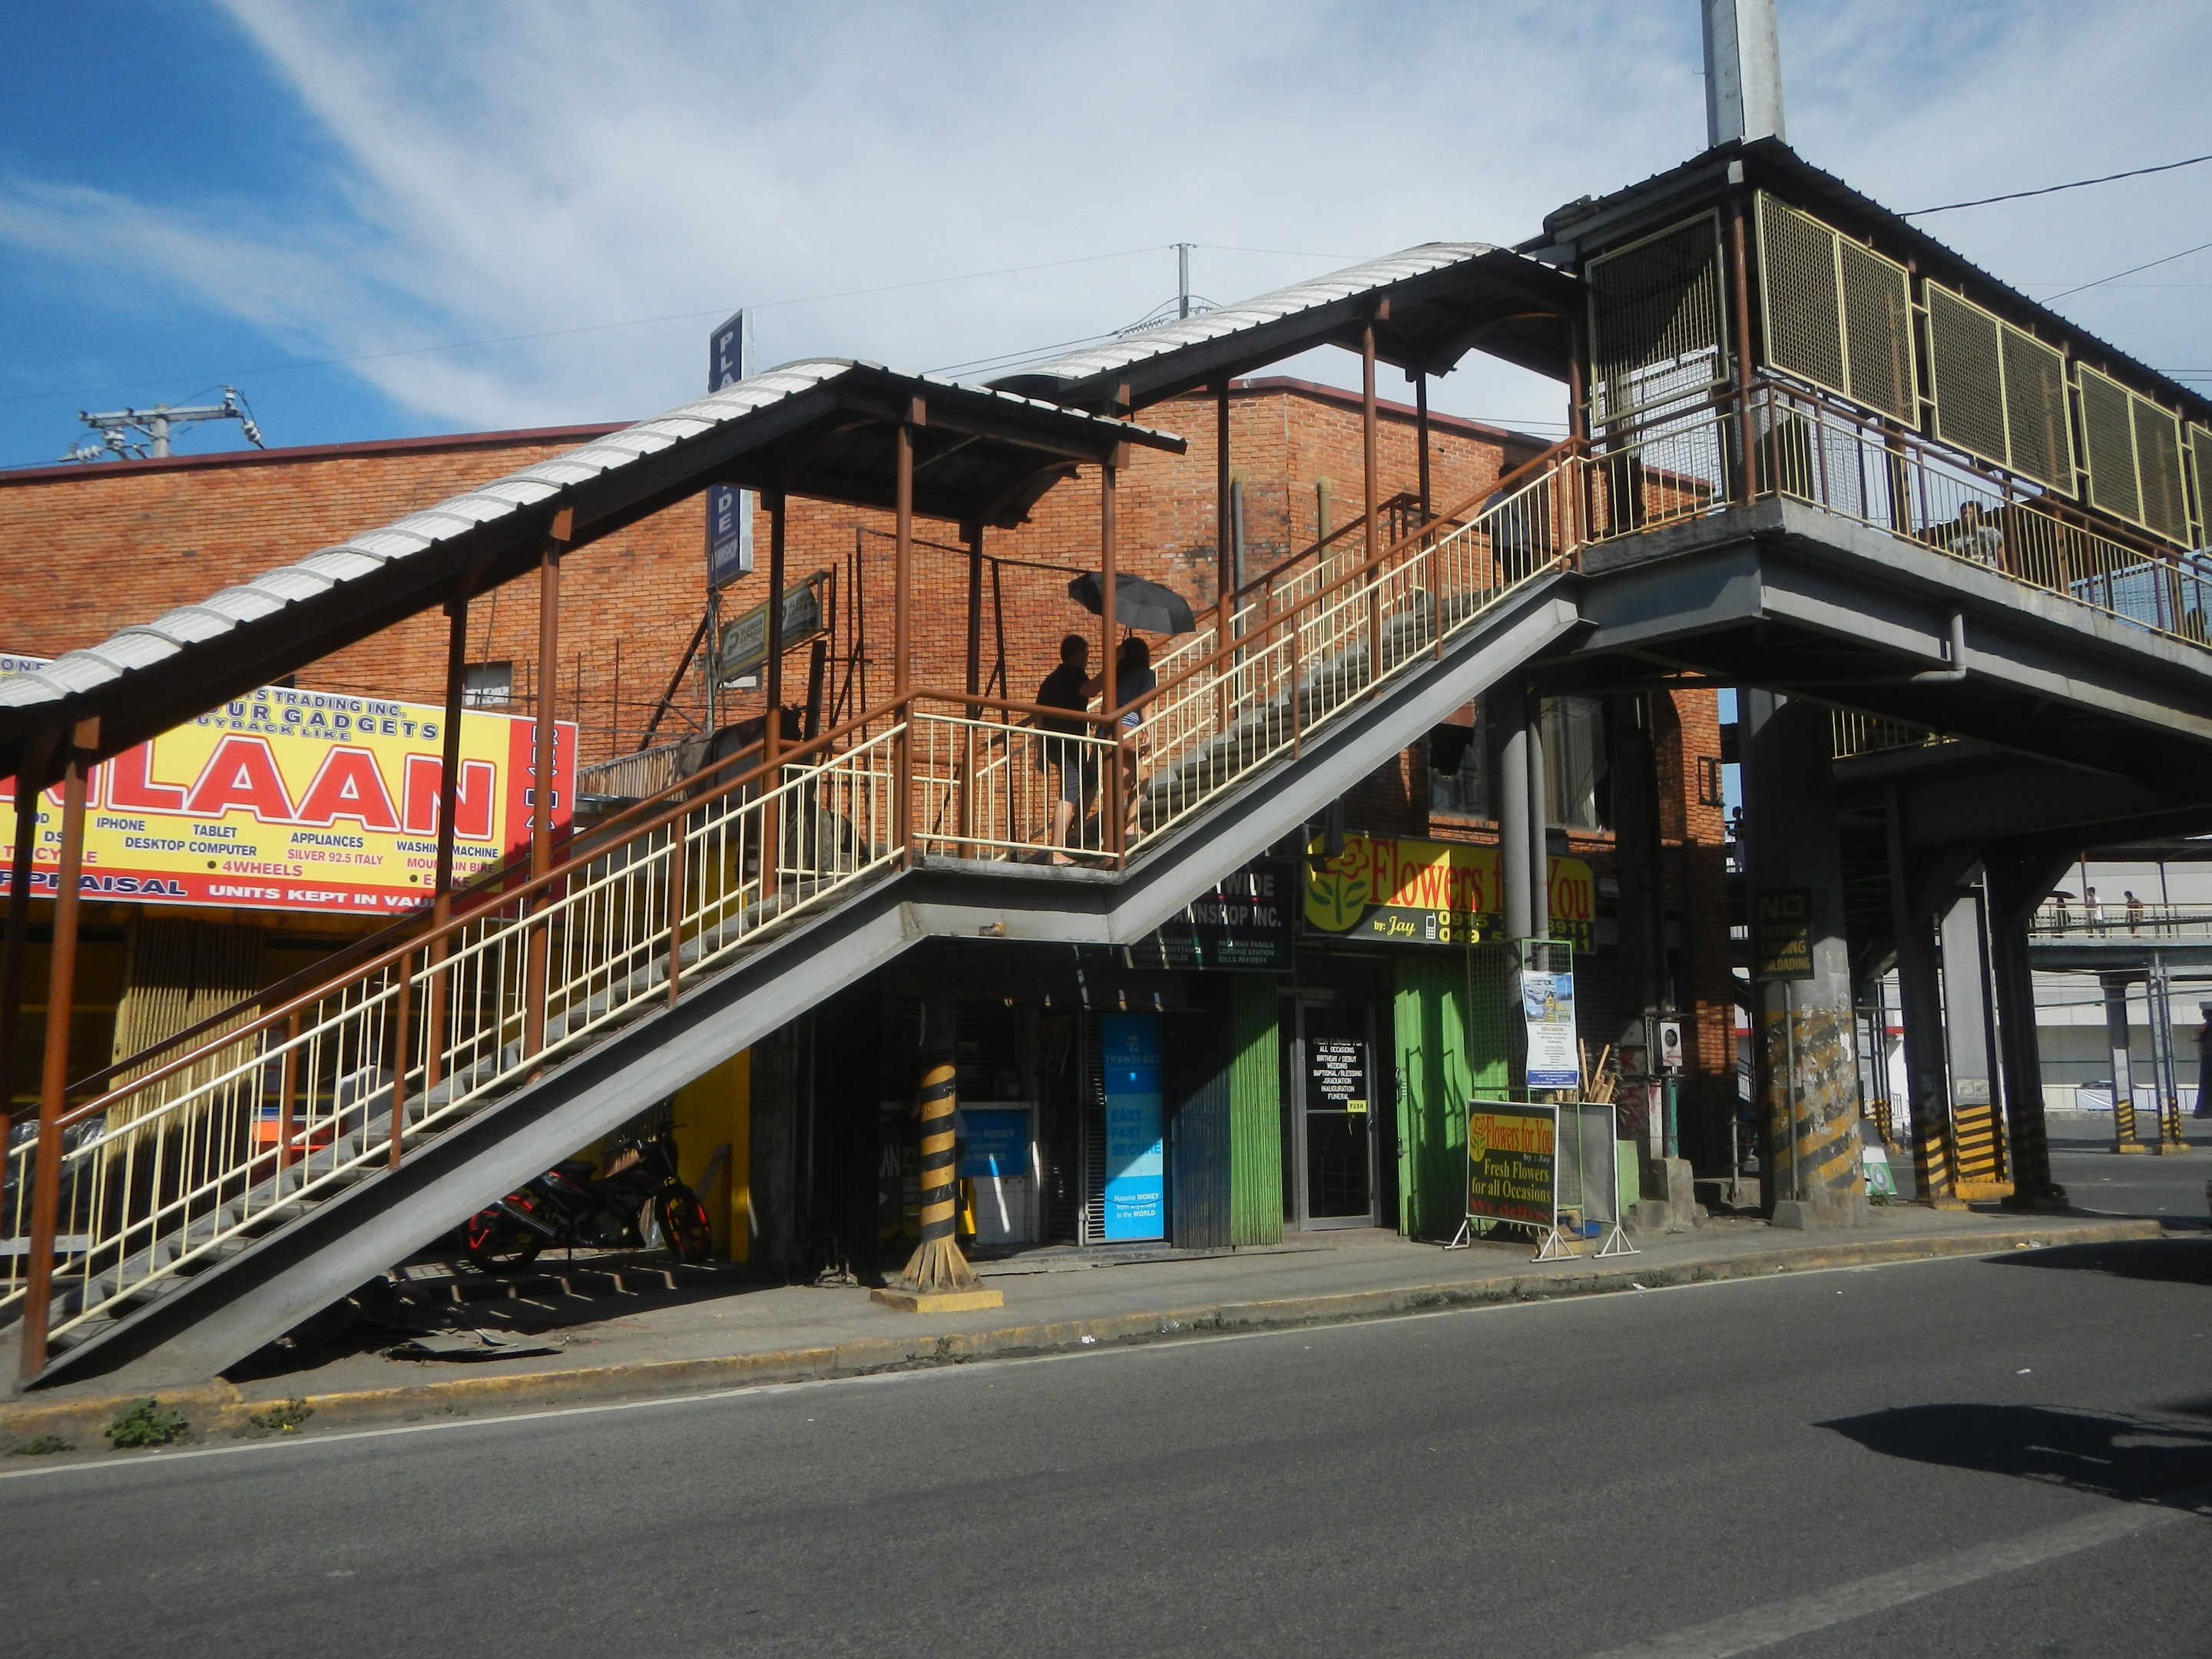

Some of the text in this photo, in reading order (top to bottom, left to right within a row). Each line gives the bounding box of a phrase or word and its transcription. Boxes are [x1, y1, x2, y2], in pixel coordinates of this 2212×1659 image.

[275, 690, 363, 713] TRADING
[368, 702, 407, 718] INC.
[284, 708, 439, 740] GADGETS
[300, 728, 351, 741] LIKE
[97, 816, 146, 832] IPHONE
[193, 824, 237, 839] TABLET
[290, 832, 363, 849] APPLIANCES
[396, 840, 439, 853] WASHIN
[125, 836, 186, 852] DESKTOP
[189, 841, 257, 857] COMPUTER
[287, 849, 325, 862] SILVER
[329, 852, 351, 863] 92.5
[354, 854, 384, 866] ITALY
[470, 862, 495, 874] BIKE
[221, 860, 303, 877] 4WHEELS
[1368, 838, 1483, 911] Flowers
[209, 884, 280, 901] UNITS
[287, 889, 348, 904] KEPT
[353, 893, 377, 906] IN
[1757, 893, 1805, 920] NO
[1373, 915, 1416, 935] by: Jay
[1111, 1109, 1143, 1122] EASY
[1111, 1126, 1143, 1139] FAST
[1486, 1115, 1553, 1154] Flowers for You
[1484, 1158, 1549, 1183] Fresh Flowers
[1523, 1153, 1532, 1163] by
[1538, 1154, 1550, 1165] Jay
[1471, 1177, 1551, 1204] for all Occasions
[1469, 1198, 1495, 1214] We
